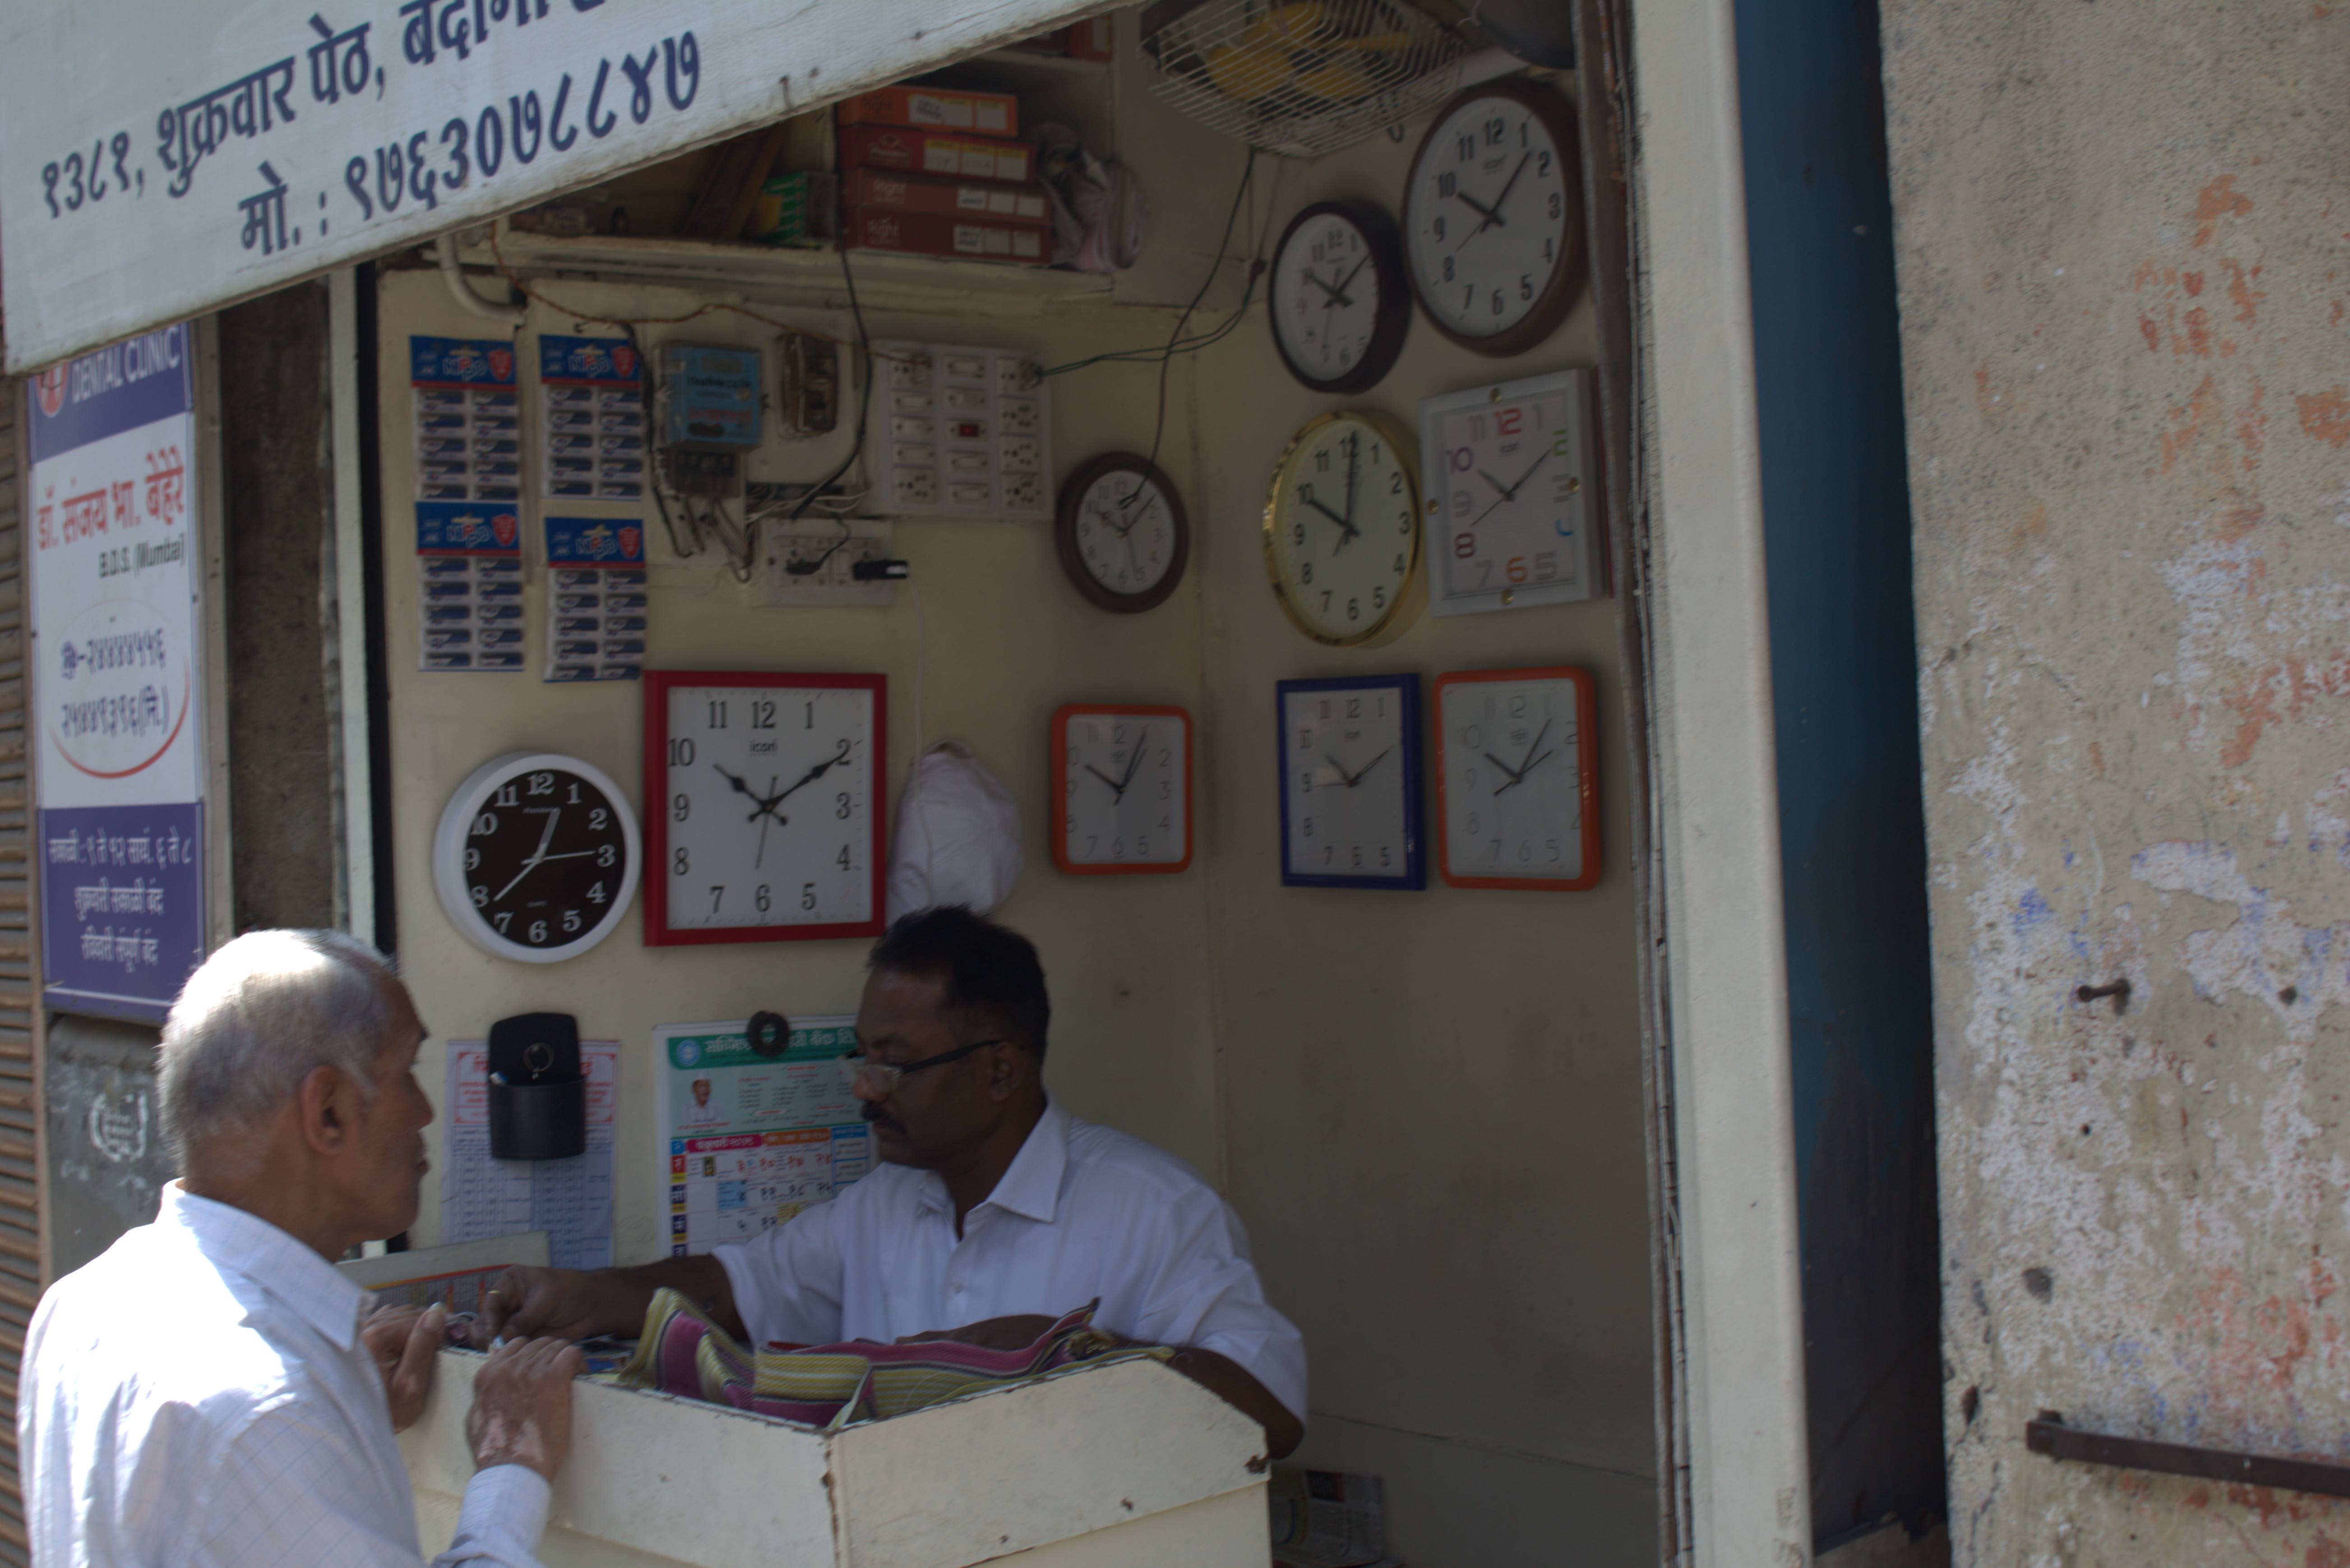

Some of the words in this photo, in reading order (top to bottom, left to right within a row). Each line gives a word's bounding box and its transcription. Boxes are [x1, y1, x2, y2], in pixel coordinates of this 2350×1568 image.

[42, 132, 144, 219] १३८१,
[158, 56, 296, 197] शुक्रवार
[308, 14, 385, 104] पेठ,
[1485, 117, 1504, 146] 12
[1520, 122, 1527, 148] 1
[1459, 134, 1474, 162] 11
[1538, 151, 1550, 178] 2
[1439, 171, 1456, 199] 10
[239, 161, 300, 256] मो.
[1548, 193, 1561, 220] 3
[1434, 217, 1445, 243] 9
[1443, 256, 1455, 282] 8
[1463, 284, 1475, 310] 7
[1522, 274, 1532, 301] 5
[1492, 289, 1503, 316] 6
[73, 346, 123, 404] DENTAL
[125, 328, 180, 383] CLINIC
[1494, 408, 1522, 436] 12
[1315, 450, 1330, 472] 11
[1371, 443, 1379, 465] 1
[1446, 447, 1473, 474] 10
[1391, 472, 1402, 494] 2
[1294, 524, 1304, 545] 9
[1399, 511, 1410, 534] 3
[1455, 533, 1476, 559] 8
[1302, 563, 1313, 584] 8
[1394, 554, 1405, 576] 4
[1506, 556, 1528, 583] 6
[1321, 590, 1332, 613] 7
[1347, 598, 1359, 620] 6
[1374, 586, 1384, 609] 5
[708, 701, 728, 729] 11
[751, 701, 776, 729] 12
[805, 701, 814, 729] 1
[668, 738, 695, 767] 10
[836, 738, 851, 766] 2
[494, 784, 520, 807] 11
[527, 772, 555, 795] 12
[567, 782, 582, 804] 1
[588, 807, 608, 830] 2
[674, 793, 689, 821] 9
[836, 792, 851, 820] 3
[470, 812, 498, 835] 10
[464, 848, 481, 871] 9
[597, 844, 615, 867] 3
[674, 847, 689, 875] 8
[836, 844, 851, 871] 4
[471, 885, 489, 908] 8
[586, 881, 606, 904] 4
[710, 885, 724, 913] 7
[755, 884, 770, 912] 6
[802, 883, 816, 910] 5
[494, 911, 513, 935] 7
[528, 920, 548, 943] 6
[562, 909, 582, 932] 5
